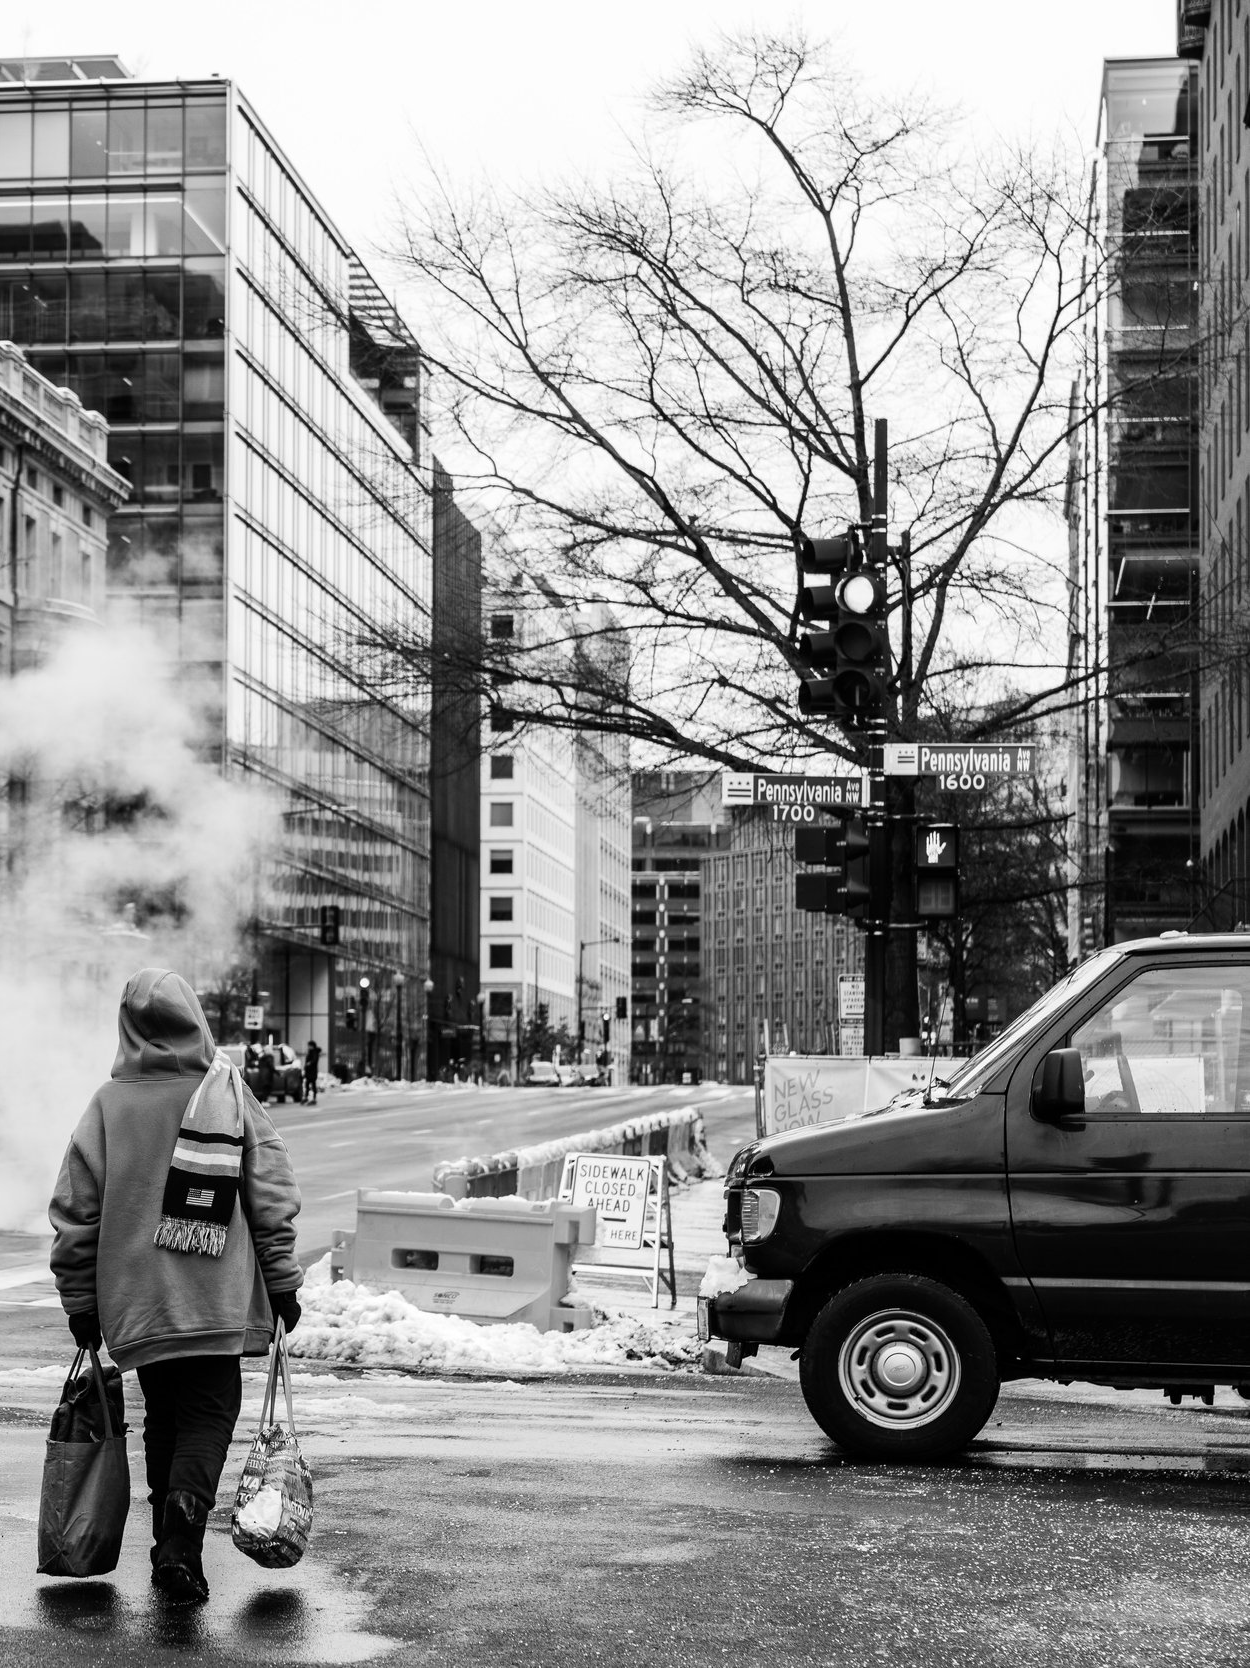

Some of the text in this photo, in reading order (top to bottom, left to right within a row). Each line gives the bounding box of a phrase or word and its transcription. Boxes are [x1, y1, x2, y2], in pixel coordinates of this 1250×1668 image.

[921, 747, 1031, 775] Pennsylvania Ave
[1017, 760, 1031, 772] NW
[939, 774, 986, 790] 1600
[757, 778, 860, 805] Pennsylvania Ave
[846, 791, 860, 803] NW
[773, 805, 815, 822] 1700
[774, 1068, 821, 1103] NEW
[774, 1086, 834, 1123] GLASS
[580, 1164, 644, 1181] SIDEWALK
[585, 1180, 636, 1197] CLOSED
[588, 1197, 631, 1212] AHEAD
[610, 1229, 638, 1241] HERE
